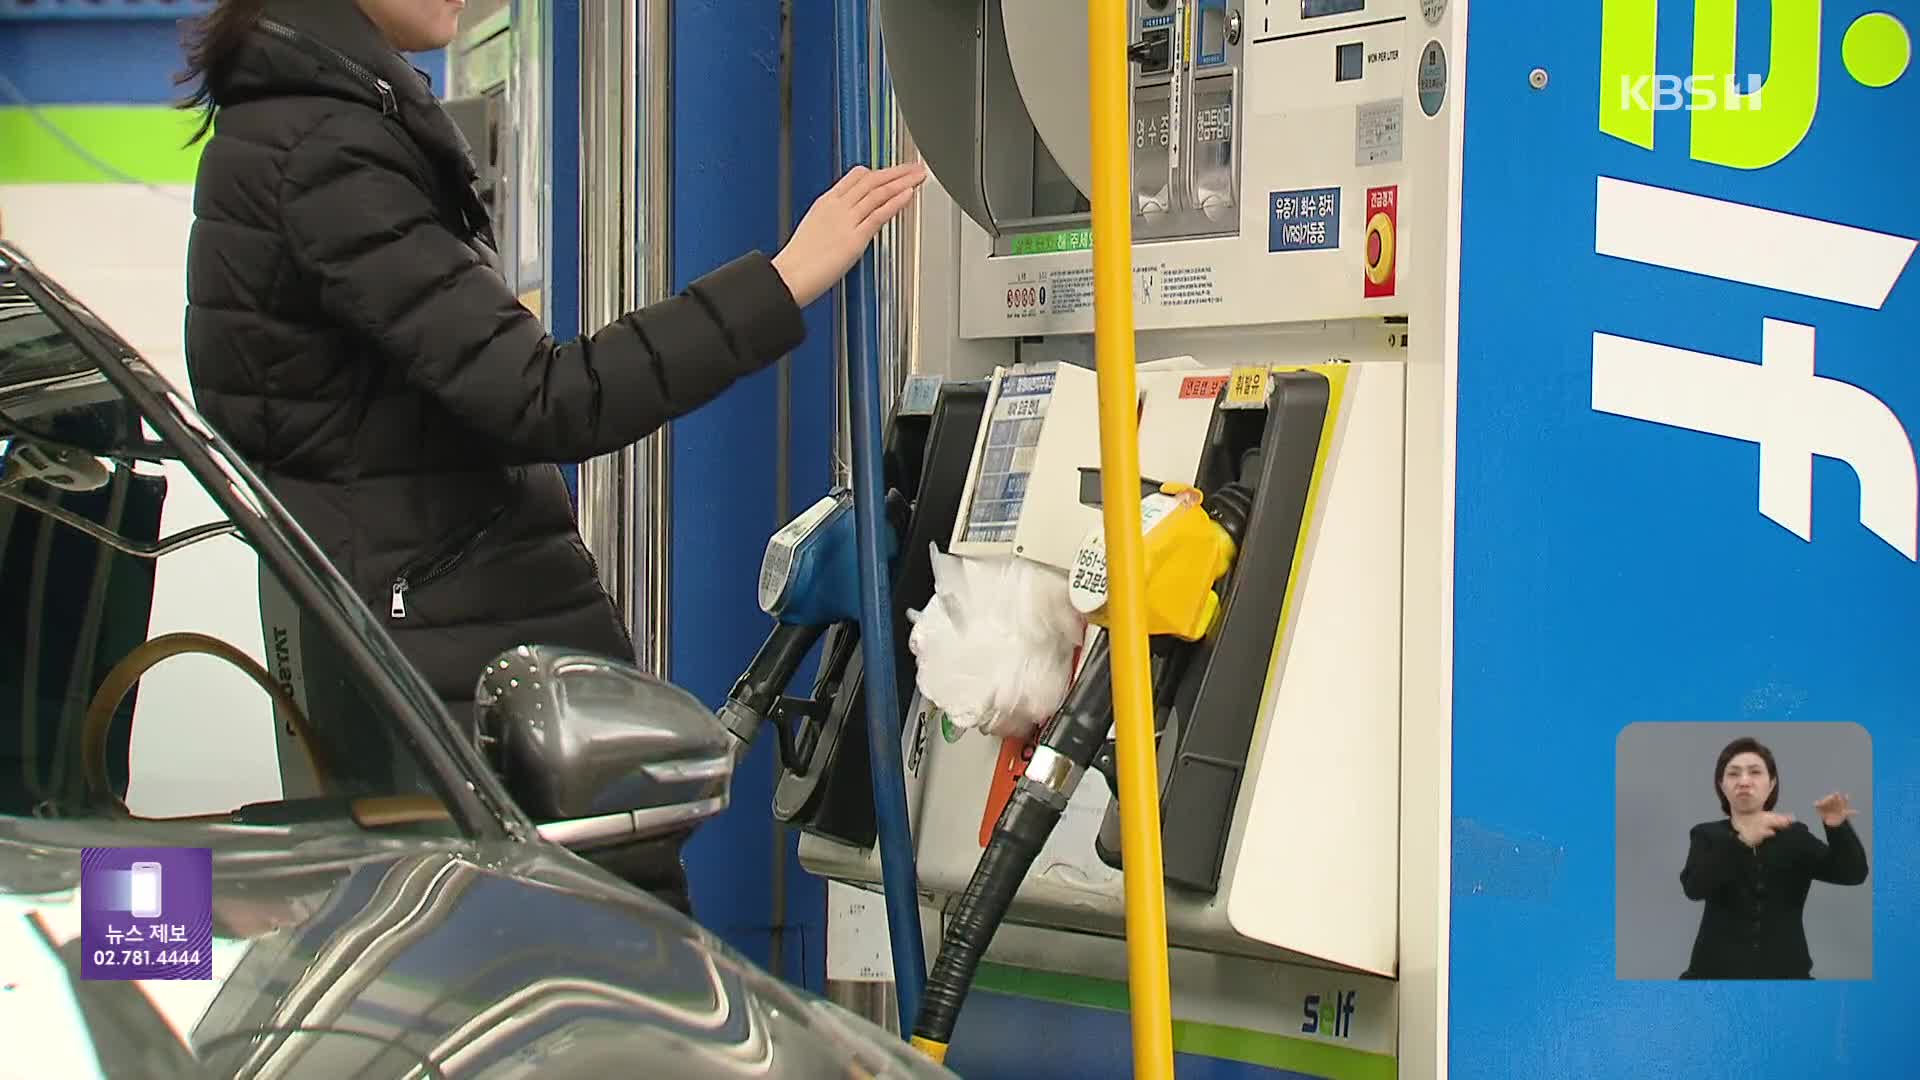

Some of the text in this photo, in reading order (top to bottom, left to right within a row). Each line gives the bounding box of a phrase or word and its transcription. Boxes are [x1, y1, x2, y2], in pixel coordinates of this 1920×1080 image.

[1136, 113, 1169, 148] 영수증
[1275, 193, 1335, 220] 유증기 회수 장치
[1370, 190, 1394, 208] 긴급정지
[1235, 374, 1261, 396] 휘발유
[1301, 990, 1357, 1038] self
